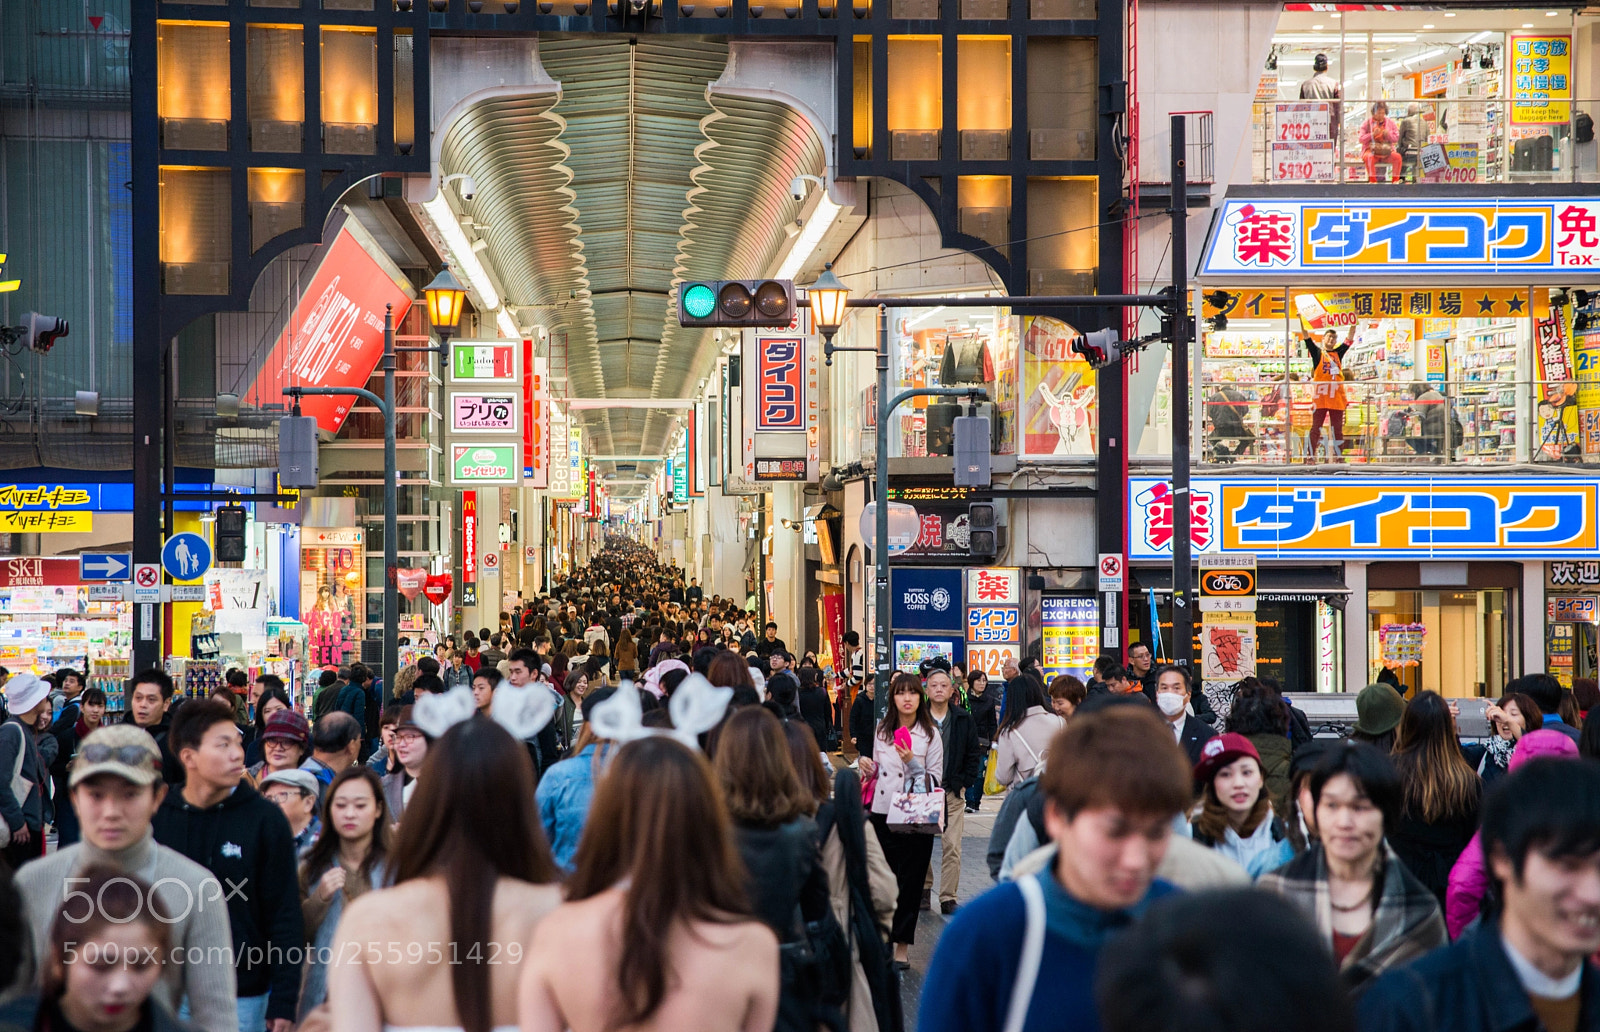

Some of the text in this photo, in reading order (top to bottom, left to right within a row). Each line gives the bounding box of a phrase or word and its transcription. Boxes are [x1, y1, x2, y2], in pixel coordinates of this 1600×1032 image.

[1516, 40, 1567, 55] 可寄放
[1516, 58, 1549, 72] 行李
[1516, 75, 1566, 90] 请慢慢
[1281, 123, 1310, 140] 2980
[1279, 162, 1312, 178] 5980
[1424, 158, 1440, 168] EX
[1445, 168, 1476, 182] 4700
[1236, 205, 1599, 263] 薬 ダイコク 免
[1557, 251, 1600, 265] Tax-
[1326, 312, 1357, 327] 4700
[1044, 338, 1086, 359] 470
[1428, 348, 1440, 359] 15
[467, 356, 501, 365] J'adore
[1564, 347, 1574, 368] board
[1577, 353, 1599, 371] 2F
[766, 342, 798, 424] ダイコク
[460, 404, 507, 420] プリ 7F
[809, 401, 818, 462] ヒロタビル
[550, 425, 568, 493] Bershka
[757, 461, 804, 473] 個室日焼
[463, 466, 507, 477] サイゼリヤ
[0, 486, 89, 508] マツモトキヨシ
[5, 511, 76, 530] マツモトキヨシ
[1231, 487, 1587, 546] ダイコク
[917, 514, 942, 546] 焼
[465, 516, 475, 571] McDonald's
[8, 560, 43, 577] SK-II
[1552, 562, 1600, 584] 欢迎
[90, 587, 122, 595] 自転車を除く
[977, 571, 1009, 600] 薬
[904, 593, 929, 604] BOSS
[1042, 599, 1096, 608] CURRENCY
[1557, 600, 1593, 611] ダイコク
[969, 609, 1018, 626] ダイコク
[975, 628, 1011, 640] ドラッグ
[1555, 626, 1572, 637] B1
[1321, 618, 1333, 686] レインボー
